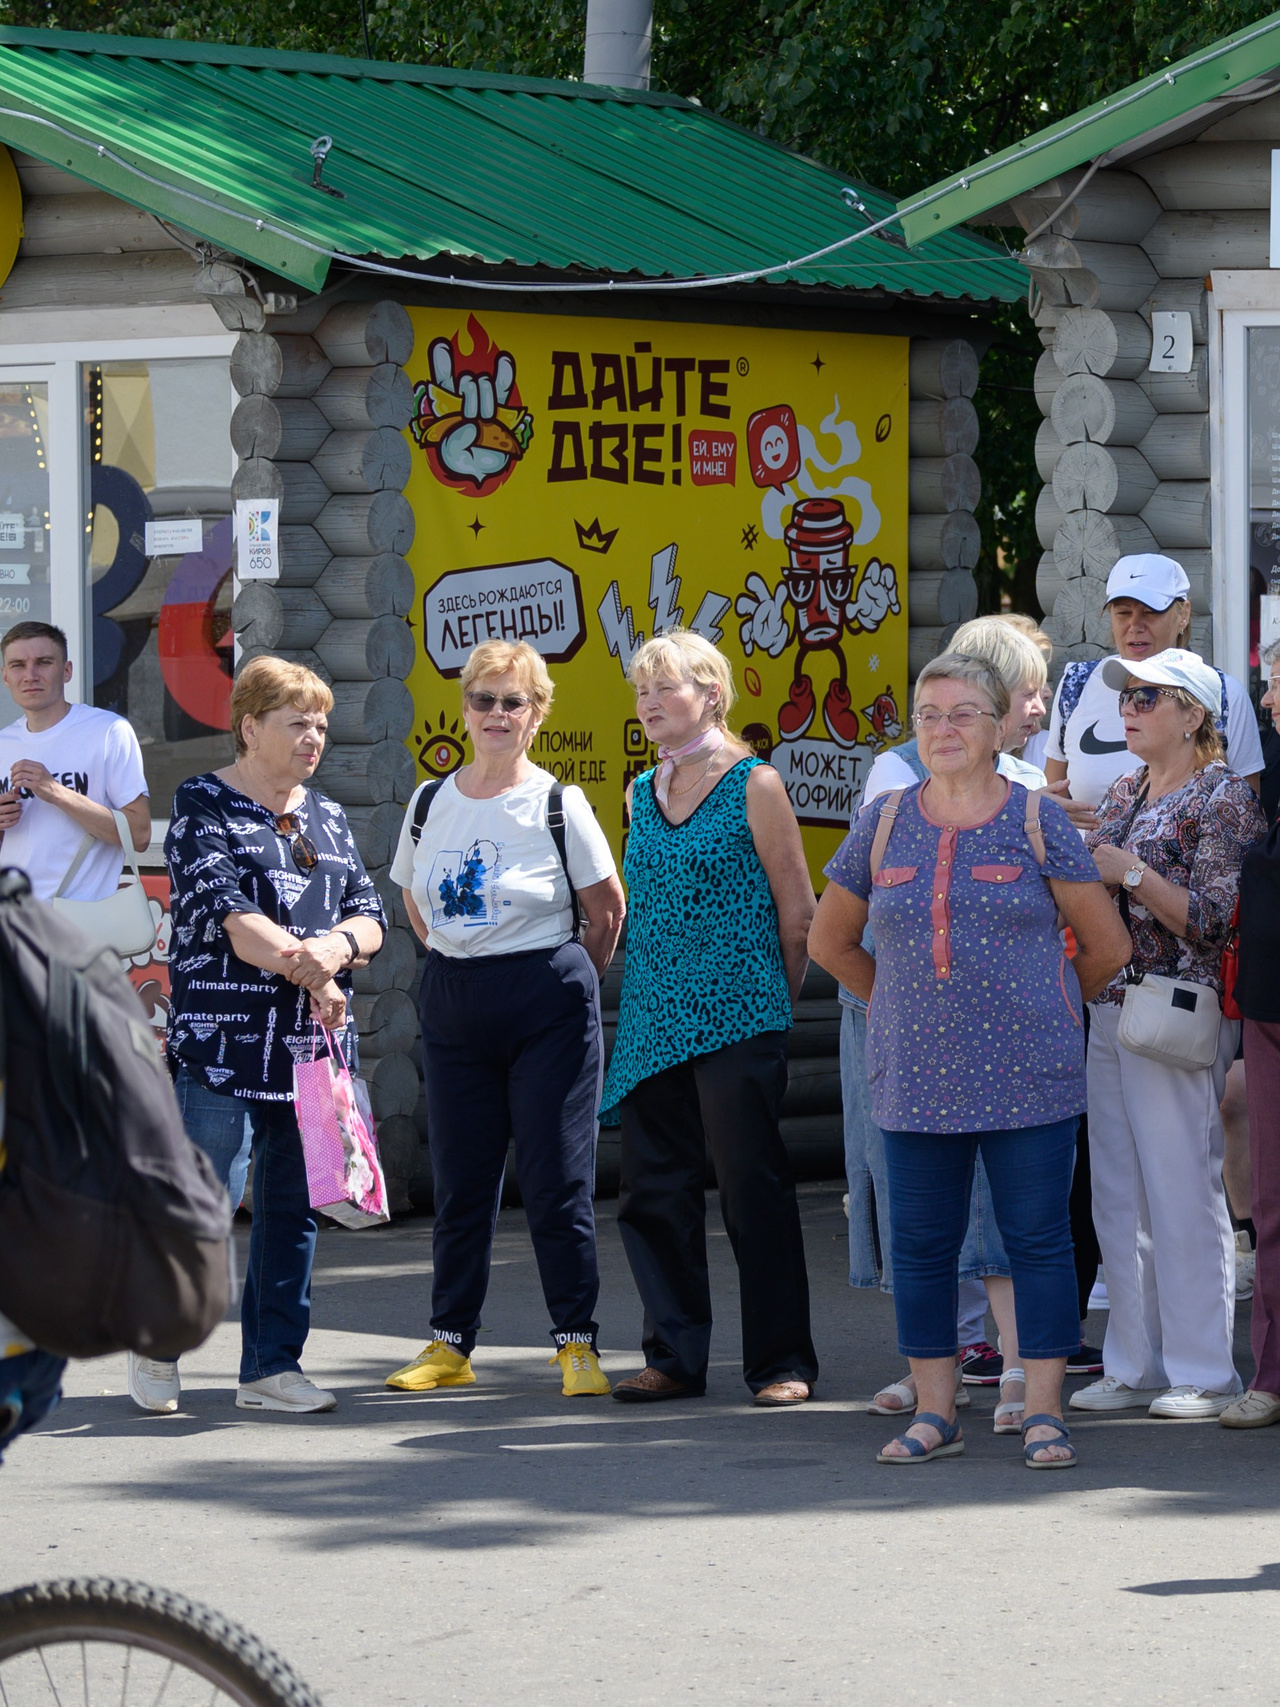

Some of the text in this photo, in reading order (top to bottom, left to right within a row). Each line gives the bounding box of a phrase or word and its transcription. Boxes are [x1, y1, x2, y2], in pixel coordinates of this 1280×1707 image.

[1162, 335, 1176, 359] 2
[547, 341, 732, 420] ДАЙТЕ
[547, 420, 682, 486] ДВЕ!
[693, 440, 735, 458] ЕЙ, ЕМУ
[693, 461, 727, 476] И МНЕ!
[249, 556, 272, 569] 650
[438, 579, 562, 613] ЗДЕСЬ РОЖДАЮТСЯ
[441, 599, 566, 652] ЛЕГЕНДЫ!
[540, 731, 593, 752] ПОМНИ
[580, 760, 607, 784] ЕДЕ
[789, 749, 862, 786] МОЖЕТ,
[240, 982, 278, 994] party
[215, 1013, 251, 1023] party
[262, 1006, 278, 1082] AUTHENTIC
[234, 1088, 285, 1101] ultimate
[554, 1333, 592, 1345] YOUNG
